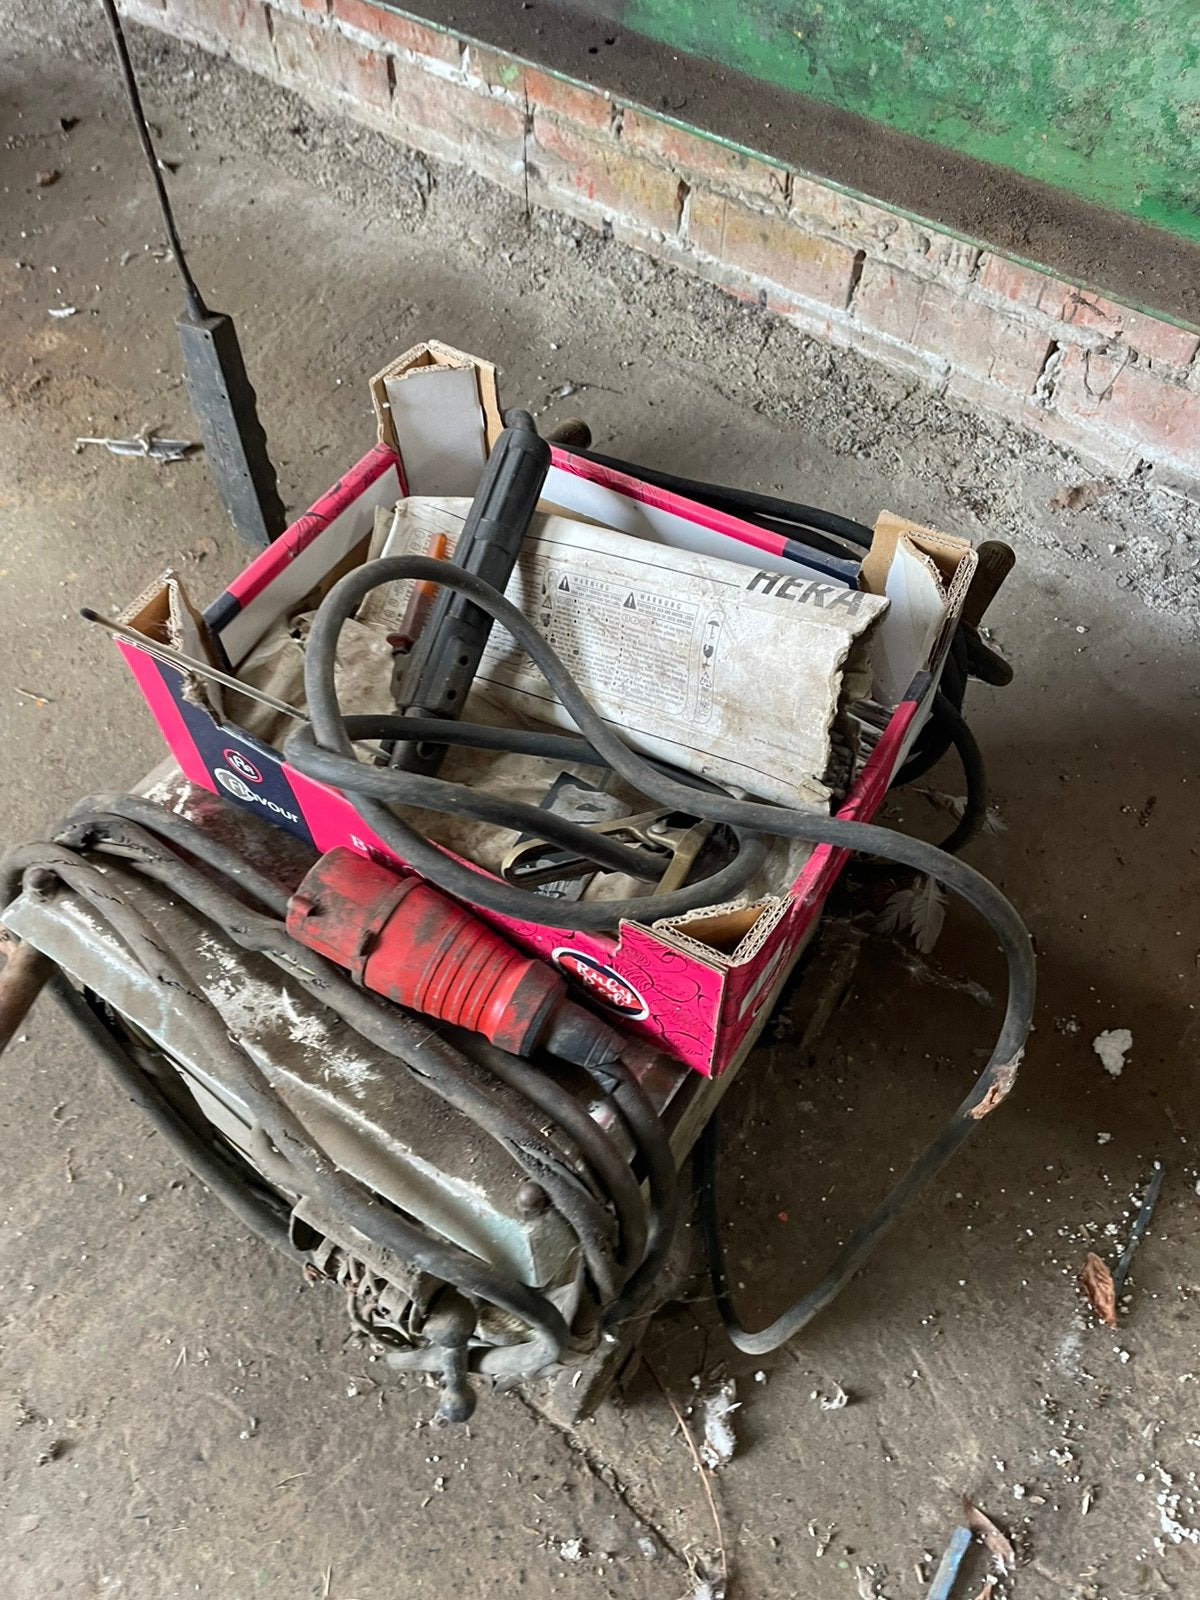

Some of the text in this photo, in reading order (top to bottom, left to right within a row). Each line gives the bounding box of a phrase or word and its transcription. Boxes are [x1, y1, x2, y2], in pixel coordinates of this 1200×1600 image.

[572, 577, 610, 591] WARNING
[640, 594, 682, 610] WARNUNG
[746, 569, 865, 616] HEKA
[228, 778, 299, 824] Flavour
[575, 960, 634, 1005] Ruby
